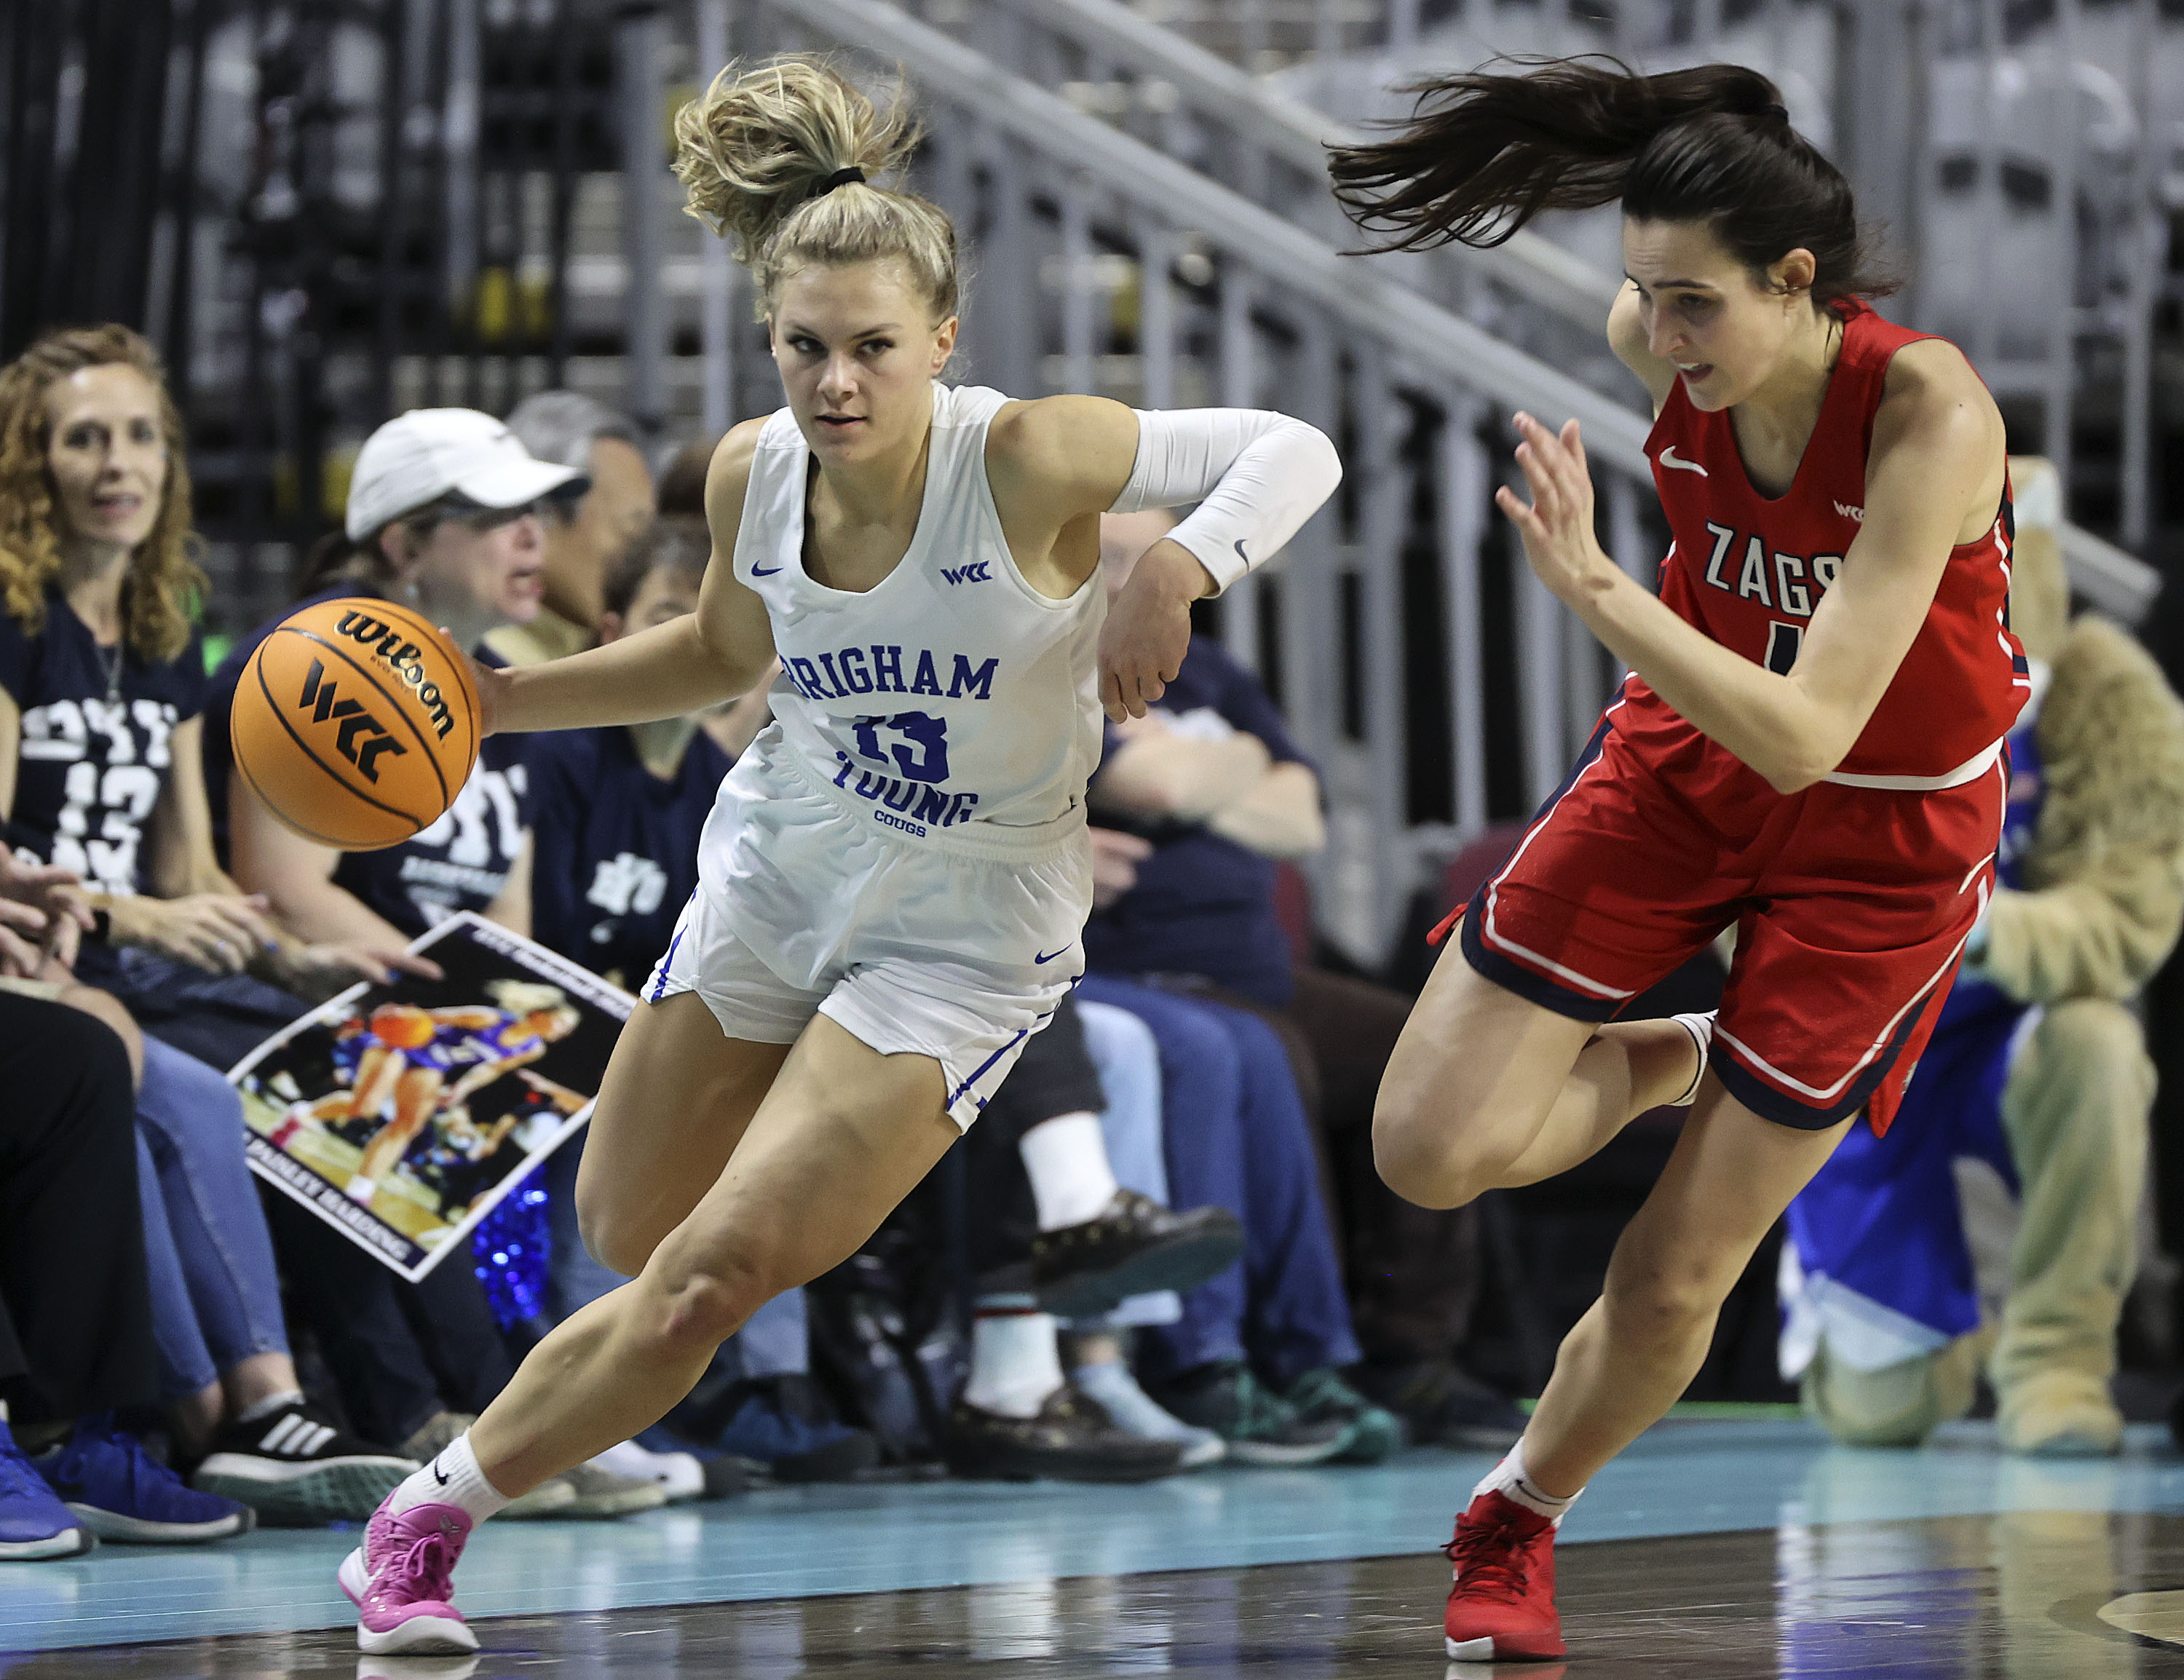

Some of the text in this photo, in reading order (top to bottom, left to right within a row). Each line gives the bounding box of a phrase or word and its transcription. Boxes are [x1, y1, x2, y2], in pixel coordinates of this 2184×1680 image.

[940, 560, 993, 585] WCC
[333, 610, 454, 742] Wilson
[298, 656, 408, 785] WCC
[852, 710, 950, 785] 13
[874, 809, 927, 838] COUGS
